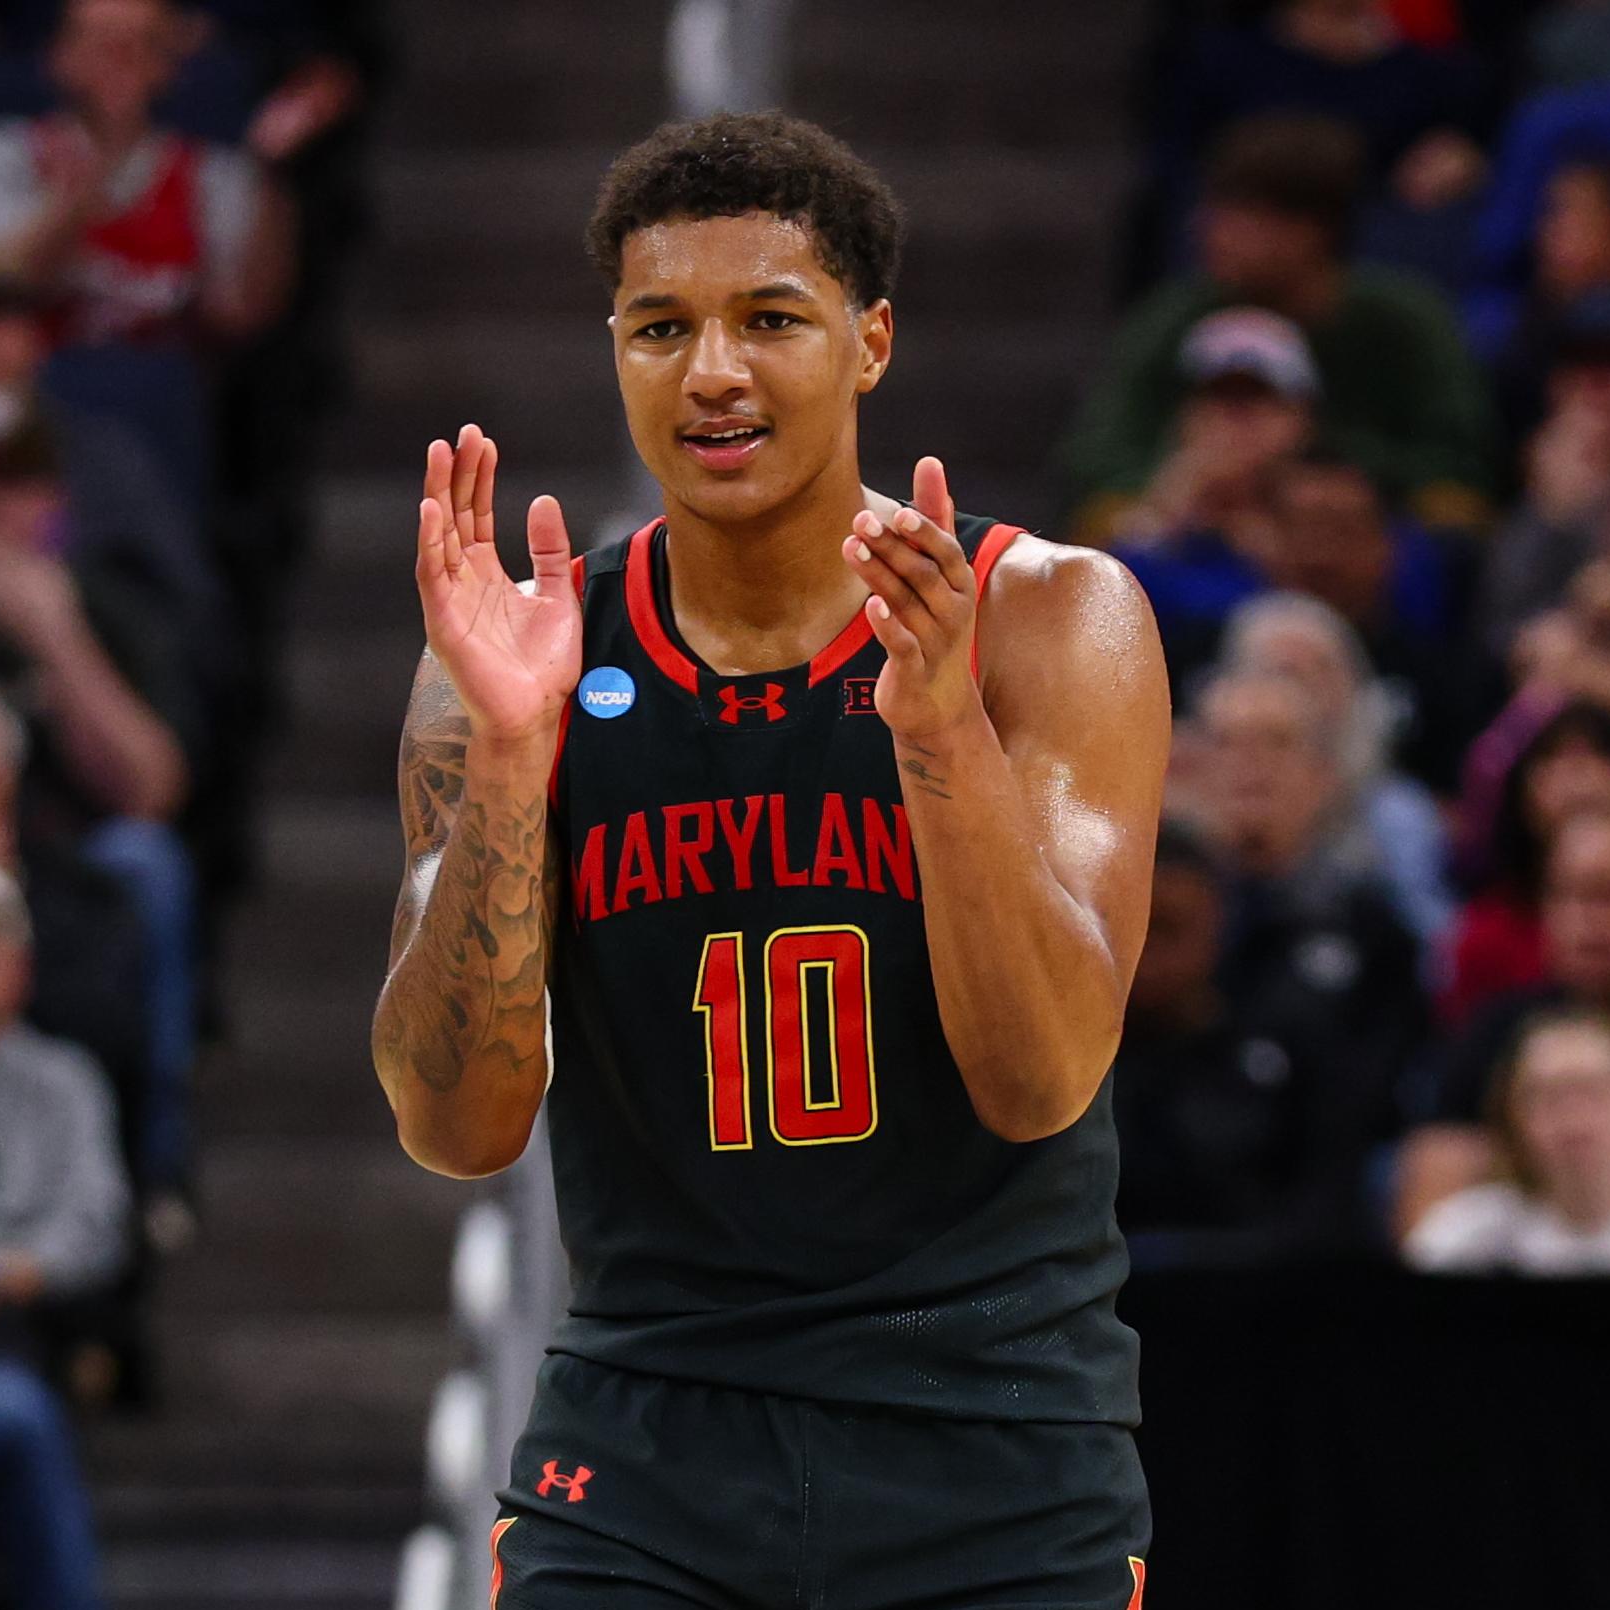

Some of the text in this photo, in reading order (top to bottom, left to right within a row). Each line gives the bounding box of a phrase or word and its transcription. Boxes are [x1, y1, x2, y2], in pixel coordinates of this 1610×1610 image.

[585, 690, 632, 705] NCAA
[571, 792, 923, 933] MARYLAN
[692, 923, 878, 1152] 10
